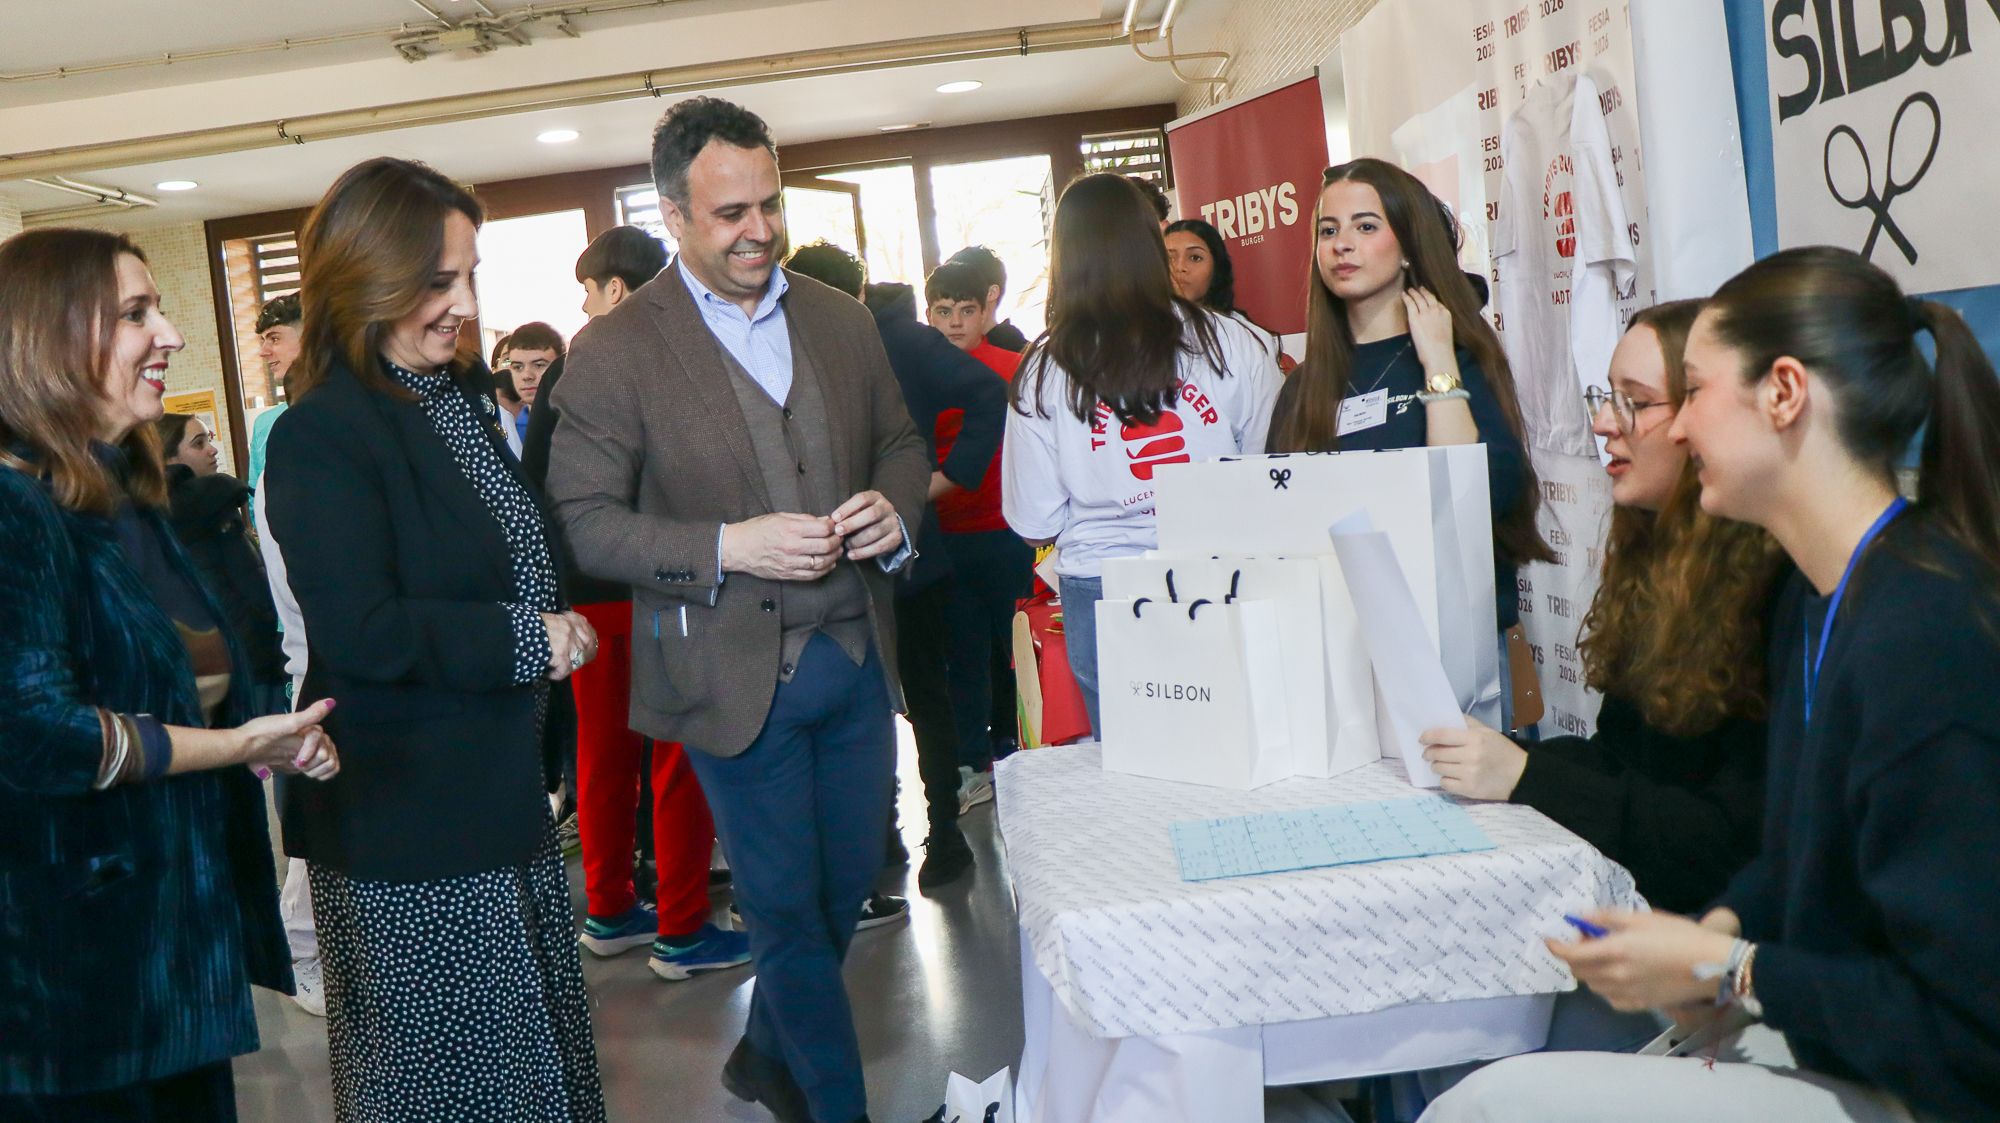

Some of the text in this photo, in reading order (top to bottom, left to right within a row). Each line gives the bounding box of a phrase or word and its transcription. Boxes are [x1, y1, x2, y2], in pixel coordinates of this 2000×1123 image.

[1540, 0, 1564, 19] 2026
[1588, 8, 1610, 34] FESIA
[1544, 40, 1582, 75] RIBYS
[1478, 86, 1499, 111] RIB
[1598, 84, 1622, 117] RIBYS
[1481, 134, 1501, 152] ESI
[1200, 181, 1299, 241] TRIBYS
[1241, 234, 1265, 247] BURGER
[1091, 399, 1114, 451] TRIB
[1542, 480, 1577, 505] TRIBYS
[1518, 578, 1534, 594] SIA
[1518, 598, 1533, 613] 026
[1554, 643, 1578, 664] FESIA
[1559, 664, 1577, 684] 2026
[1145, 682, 1211, 702] SILBON
[1551, 705, 1588, 738] TRIBYS
[1515, 874, 1535, 893] SILBON
[1325, 893, 1347, 912] SILBON
[1436, 886, 1457, 905] SILBON
[1356, 899, 1378, 918] SILBON
[1161, 917, 1184, 938] SILBON
[1192, 922, 1216, 943] SILBON
[1307, 916, 1327, 935] SILBON
[1504, 925, 1526, 944] SILBON
[1256, 935, 1277, 954] SILBON
[1367, 927, 1388, 946] SILBON
[1316, 945, 1338, 964] SILBON
[1347, 951, 1368, 969] SILBON
[1486, 949, 1506, 967] SILBON
[1237, 959, 1259, 978] SILBON
[1436, 965, 1457, 984] SILBON
[1328, 974, 1350, 993] SILBON
[1248, 988, 1271, 1007] SILBON
[1167, 1001, 1189, 1021] SILBON
